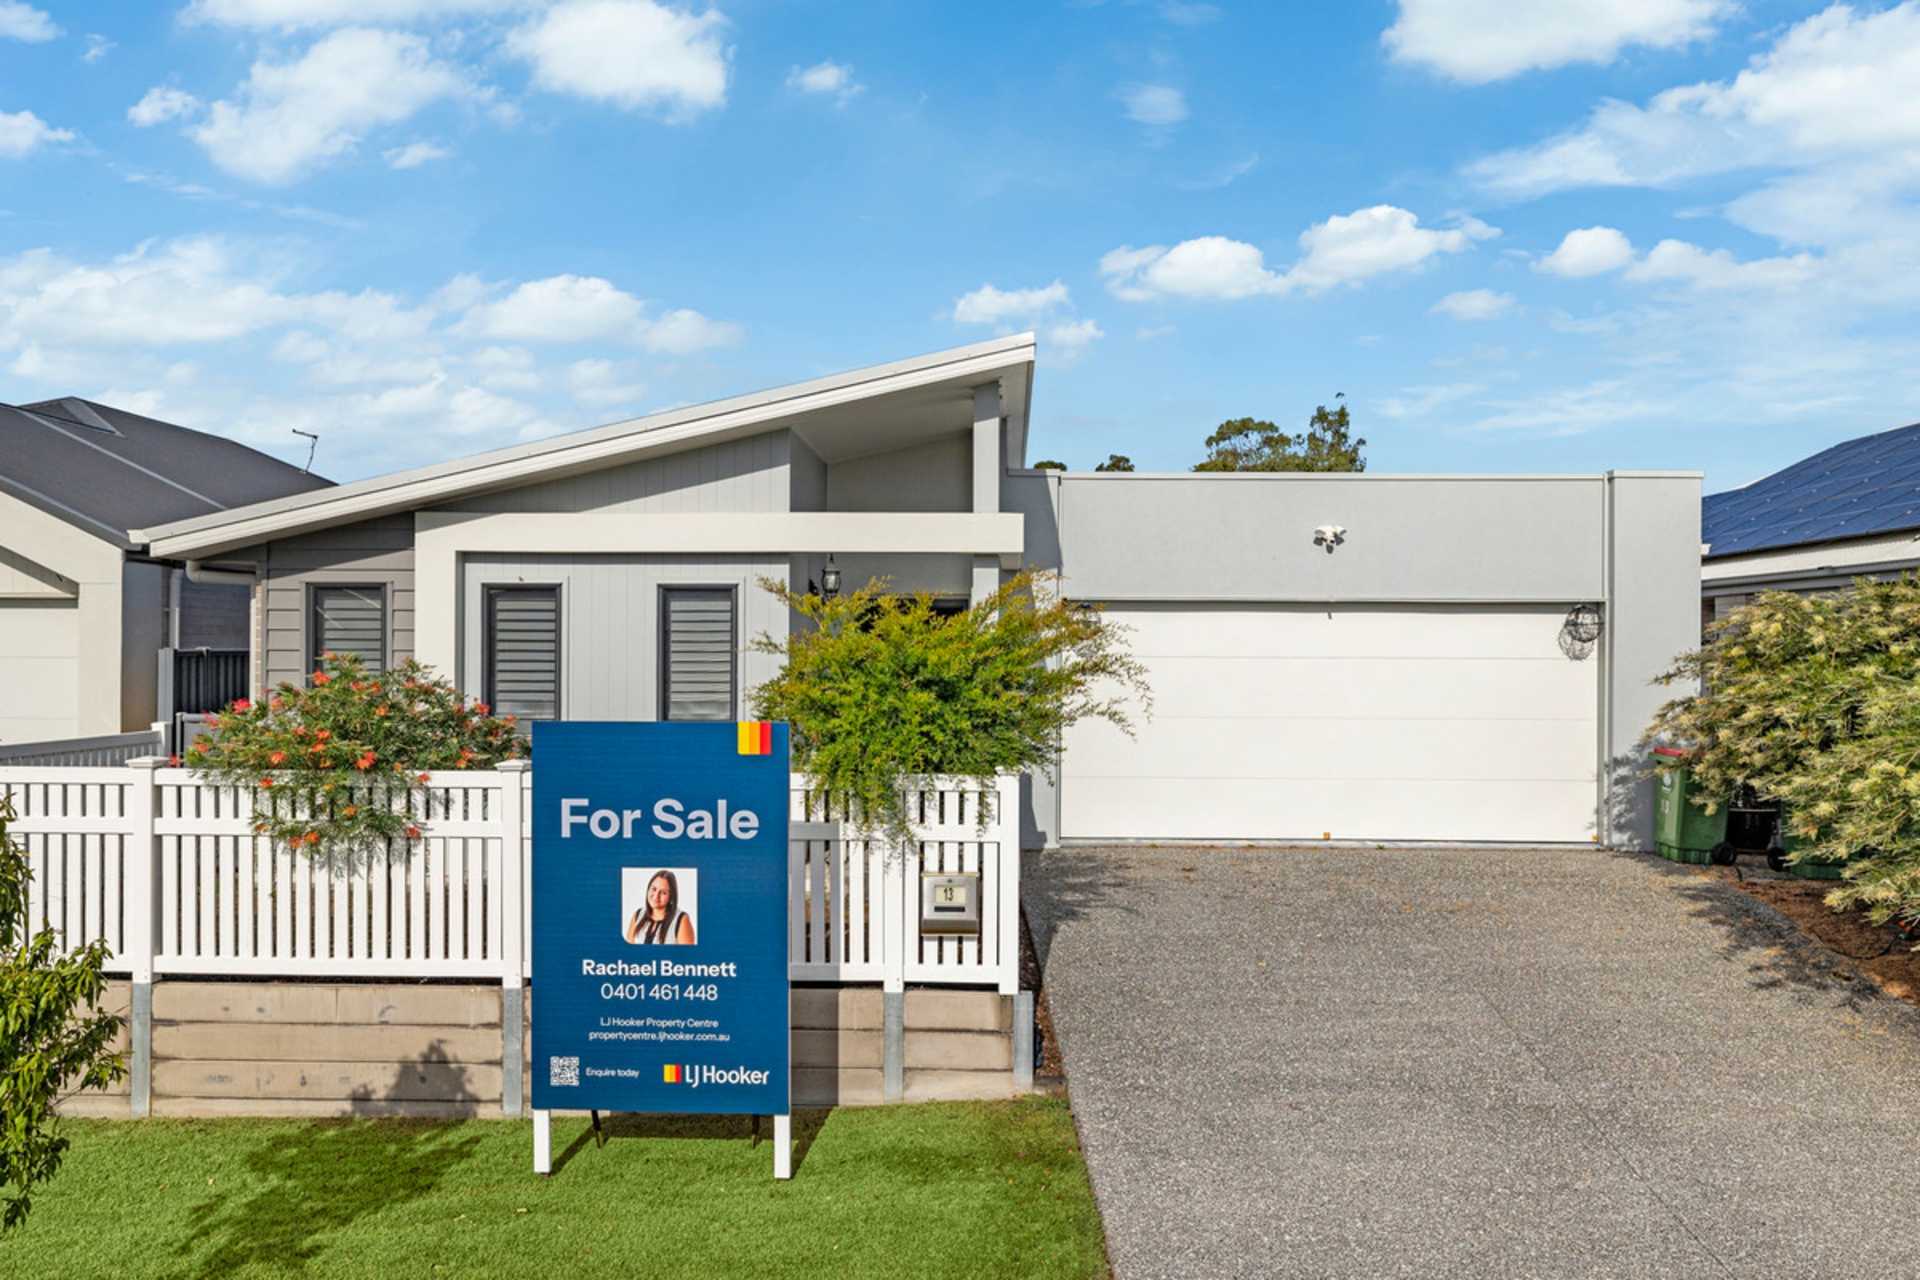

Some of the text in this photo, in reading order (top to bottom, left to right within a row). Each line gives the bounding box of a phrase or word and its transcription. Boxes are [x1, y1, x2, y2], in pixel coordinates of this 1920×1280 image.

[560, 798, 760, 840] For Sale
[943, 887, 954, 902] 13
[582, 959, 737, 978] Rachael Bennett
[600, 983, 718, 1001] 0401 461 448
[600, 1017, 719, 1029] LJ Hooker Property Centre
[588, 1031, 731, 1043] propertycentre.ljhooker.com.au
[585, 1067, 640, 1079] Enquire today
[685, 1064, 770, 1089] LJ Hooker
